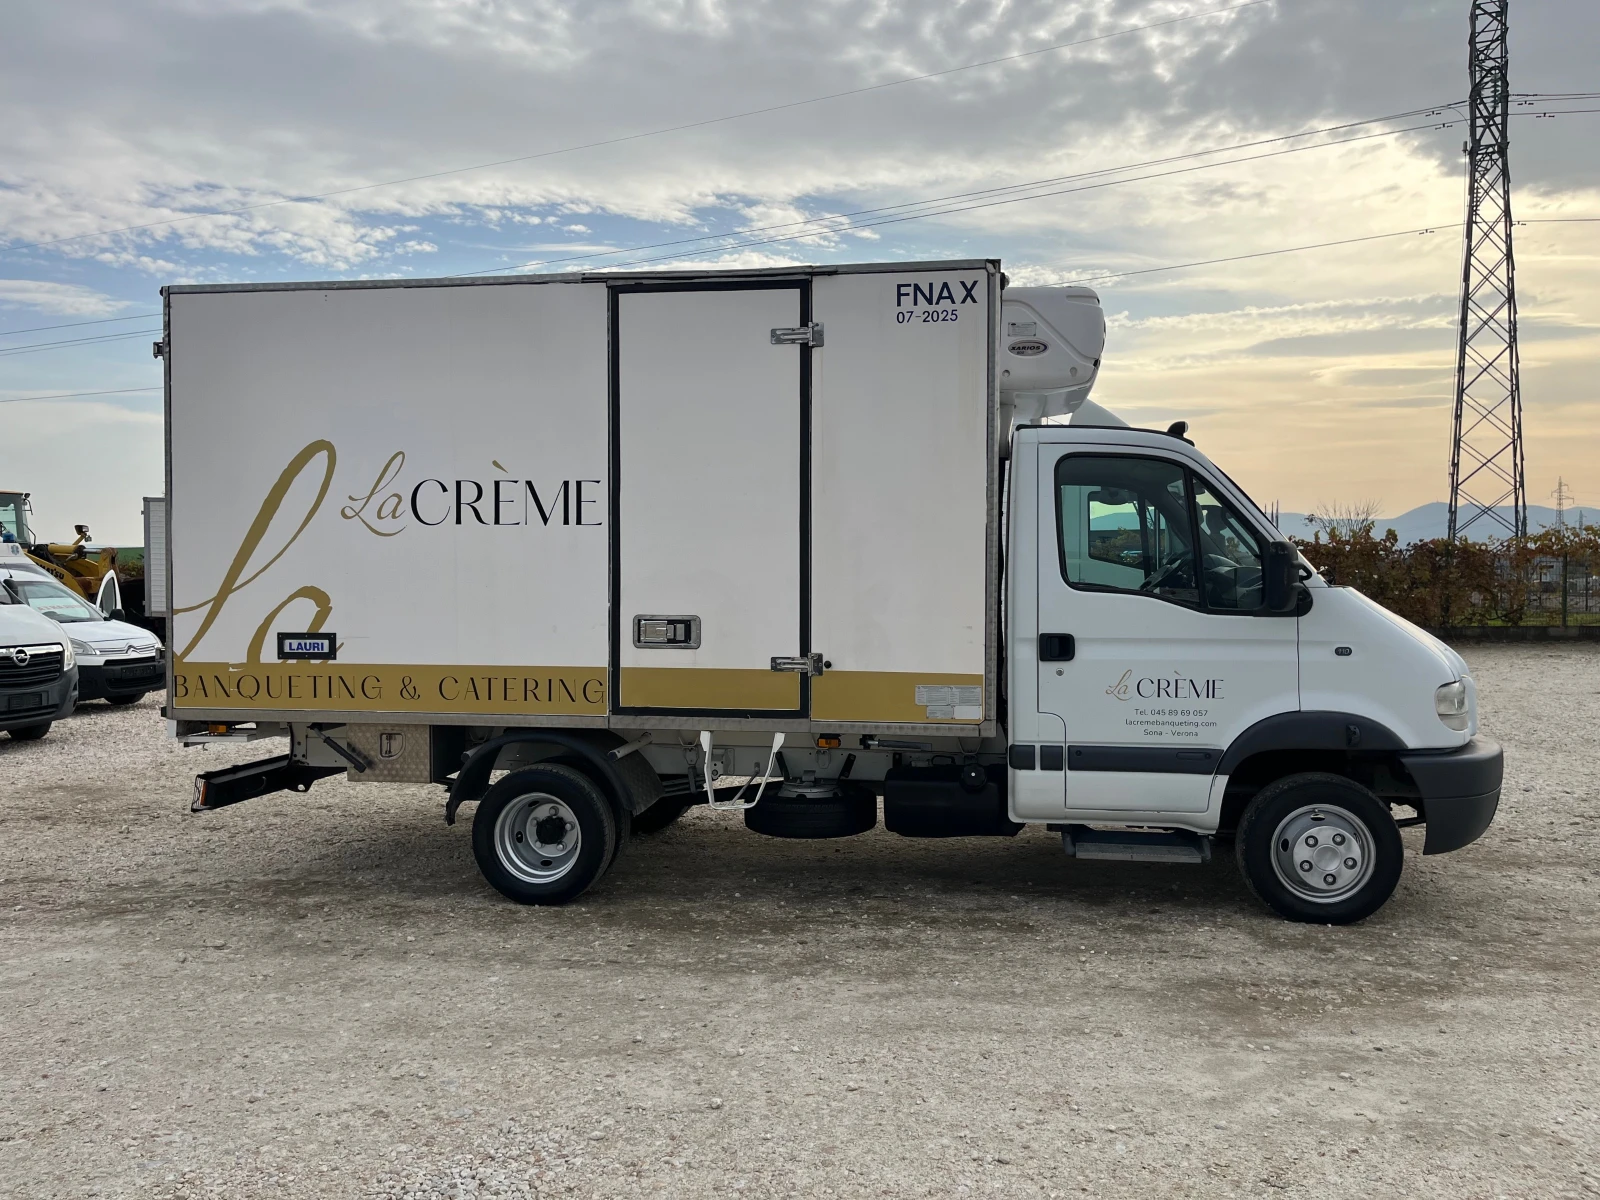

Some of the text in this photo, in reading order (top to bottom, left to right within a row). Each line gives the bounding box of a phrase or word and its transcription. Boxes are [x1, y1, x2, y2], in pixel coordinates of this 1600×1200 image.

[896, 280, 979, 307] FNAX
[896, 309, 959, 324] 07-2025
[288, 641, 325, 652] LAURI
[174, 674, 606, 704] BANQUETING & CATERING
[1105, 669, 1225, 701] La CRÈME
[1134, 708, 1149, 716] Tel.
[1180, 709, 1191, 717] 69
[1192, 709, 1208, 717] 057
[1125, 718, 1217, 728] lacremebanqueting.com
